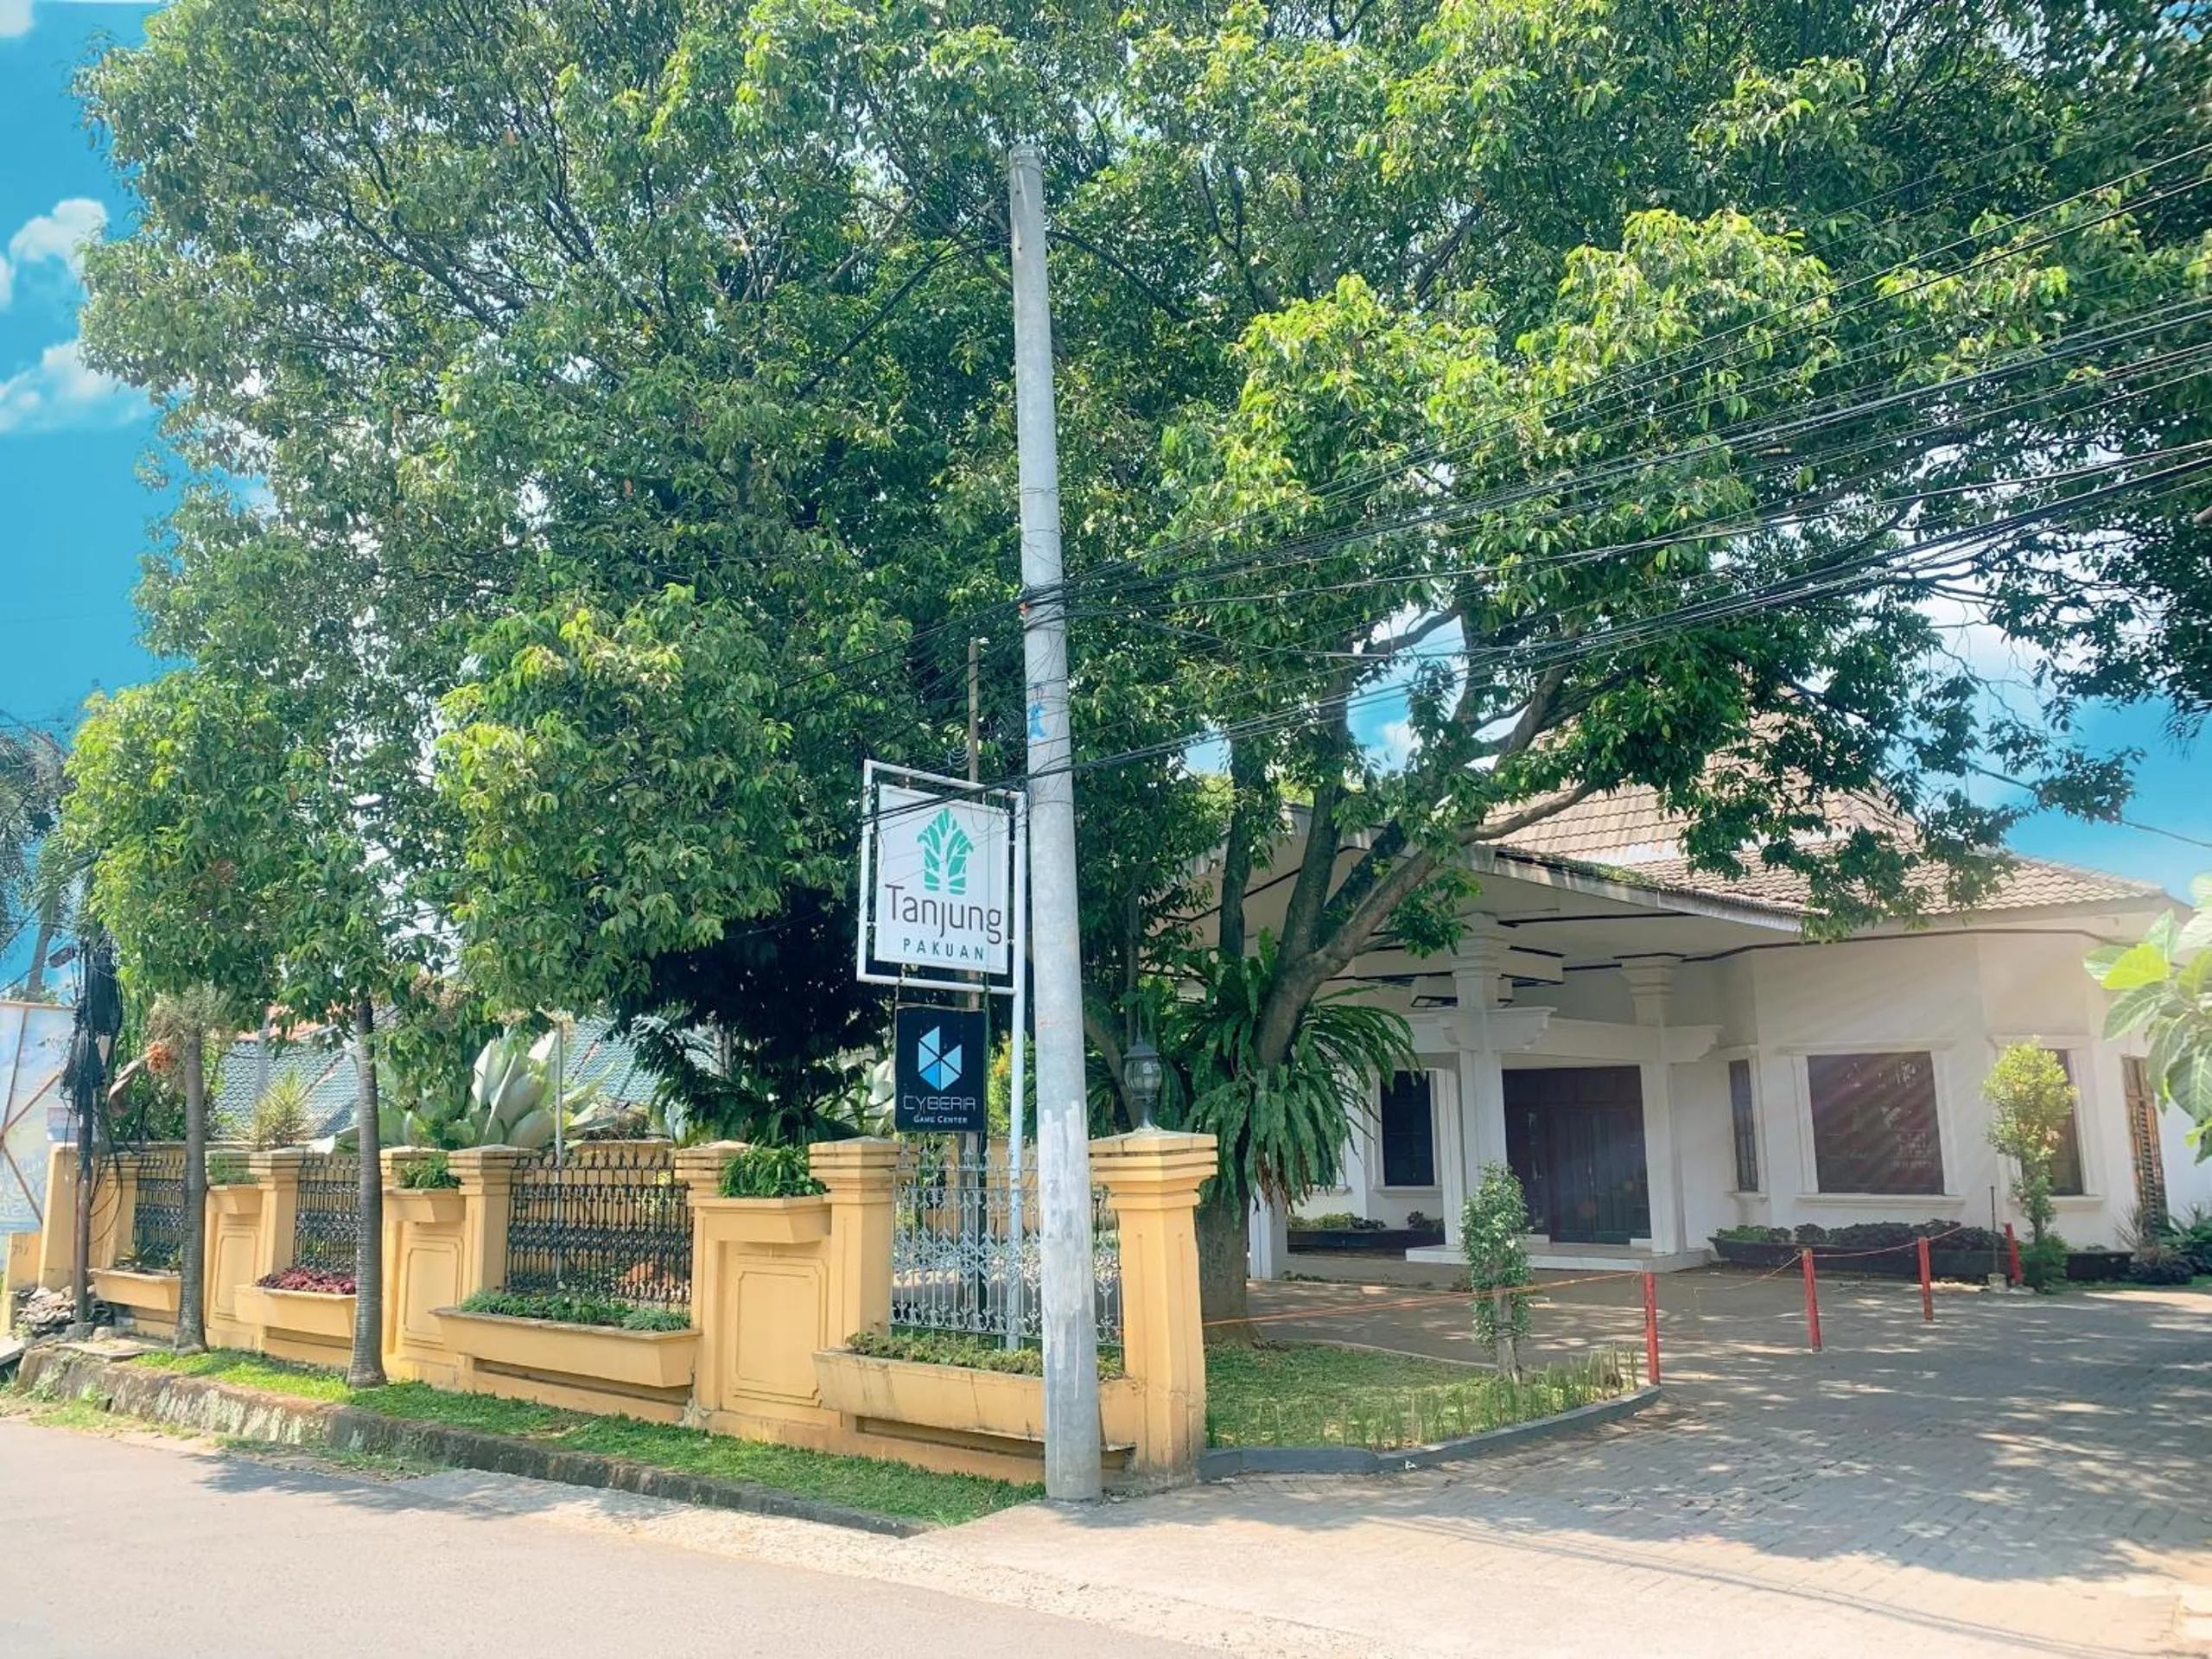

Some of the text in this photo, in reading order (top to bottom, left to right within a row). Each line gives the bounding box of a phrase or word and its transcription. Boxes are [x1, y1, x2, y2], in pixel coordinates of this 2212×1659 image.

[885, 884, 1001, 944] Tanjung
[903, 938, 984, 961] PAKUAN
[903, 1095, 976, 1111] CYBERIA
